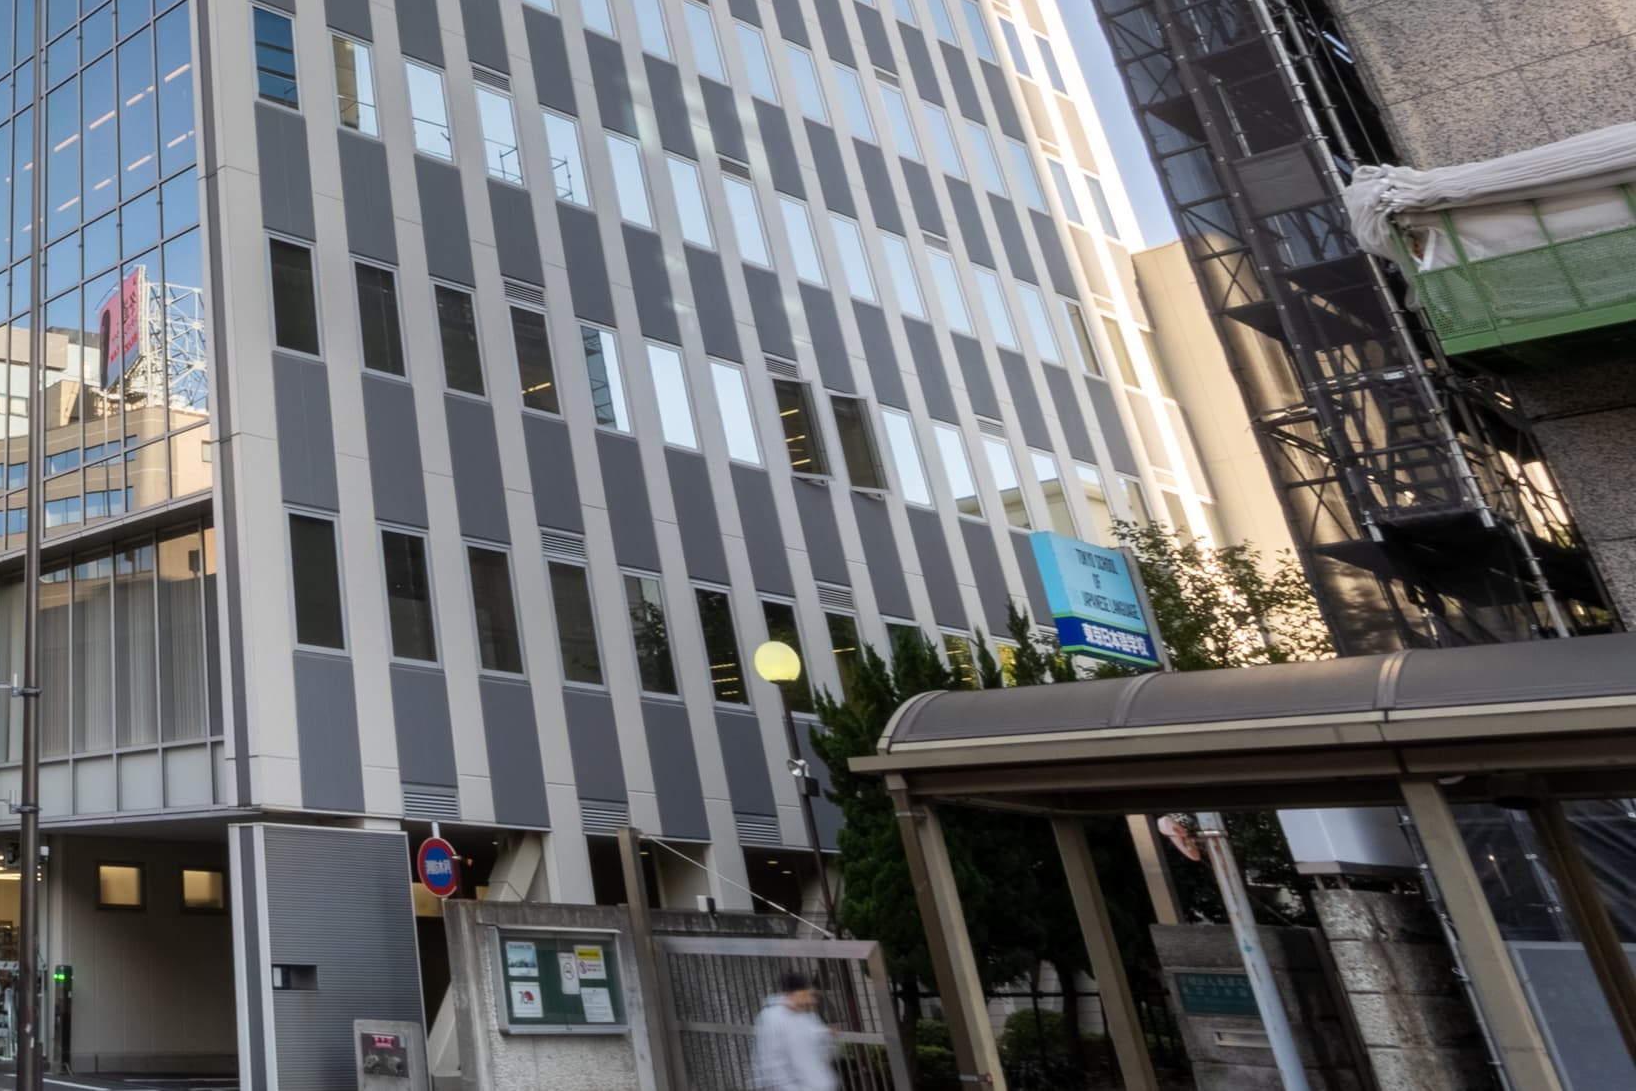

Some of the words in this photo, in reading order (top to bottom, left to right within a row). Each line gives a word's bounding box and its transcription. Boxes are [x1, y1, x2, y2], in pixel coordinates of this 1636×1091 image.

[1081, 622, 1149, 656] 東京日本語学校
